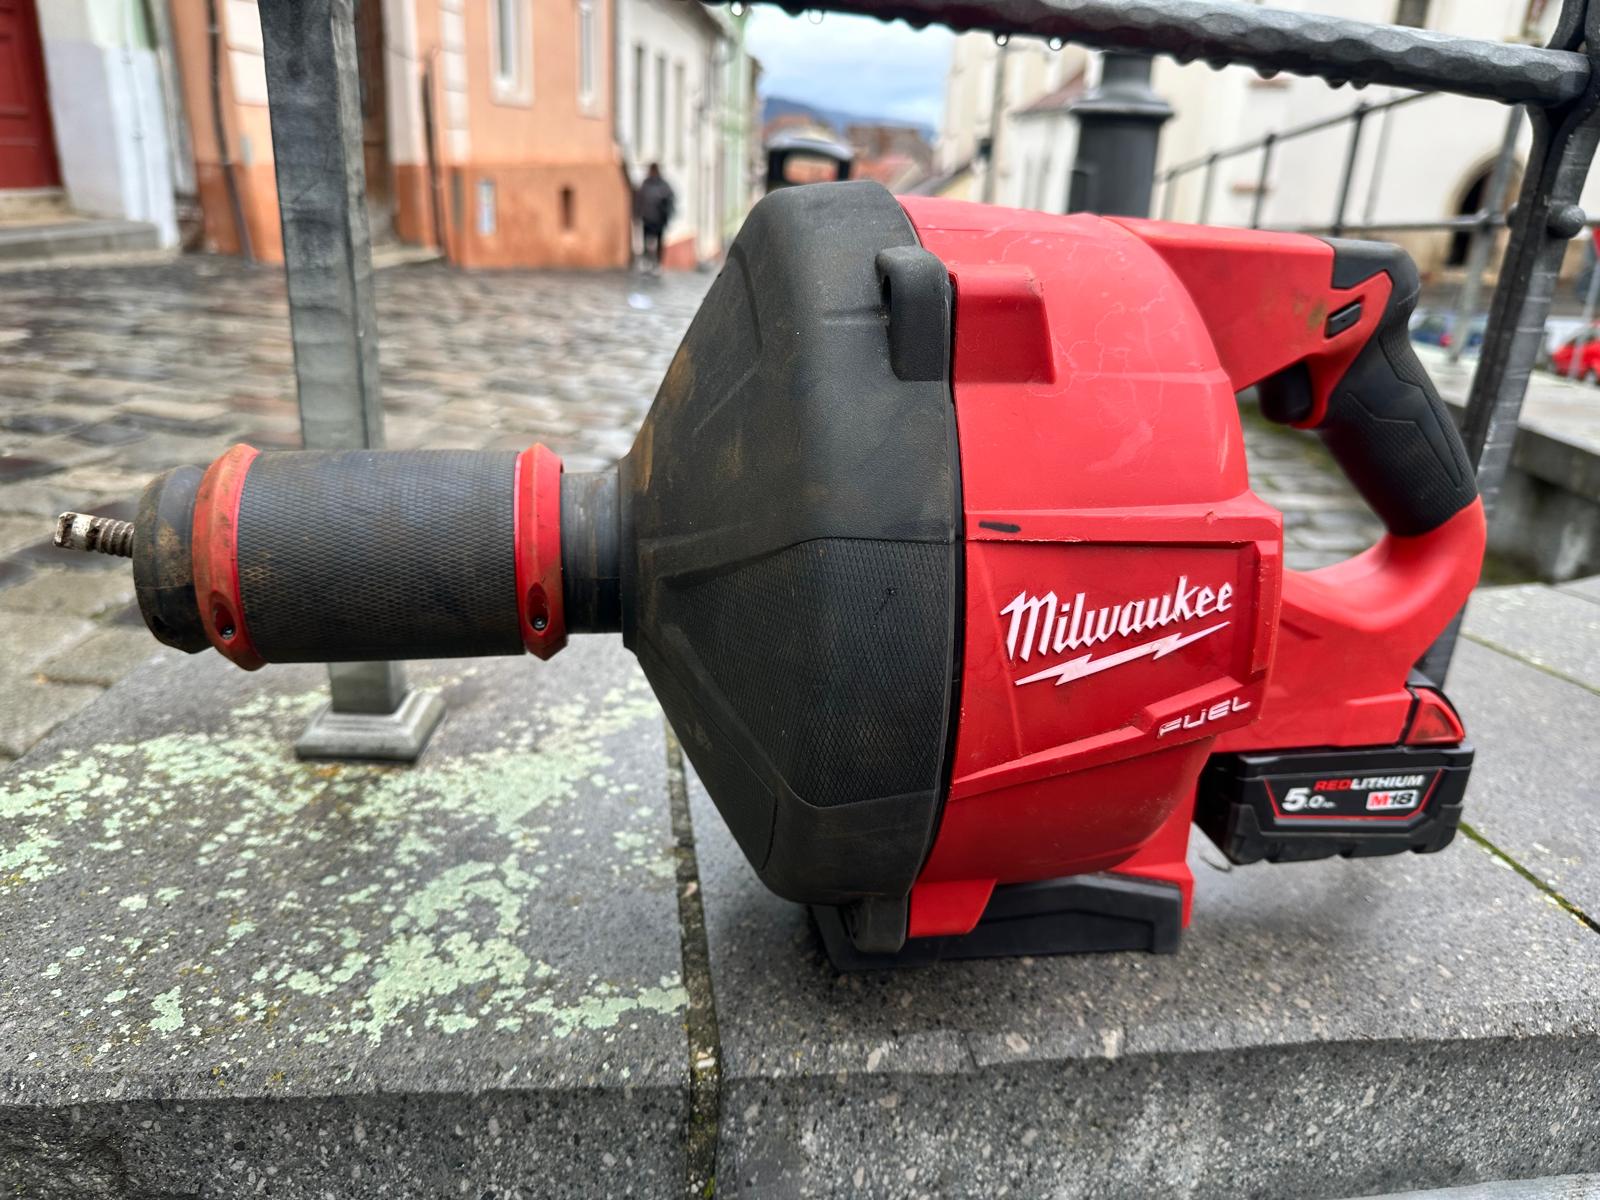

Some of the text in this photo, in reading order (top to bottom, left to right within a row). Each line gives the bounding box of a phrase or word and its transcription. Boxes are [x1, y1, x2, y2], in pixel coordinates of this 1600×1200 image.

[1000, 576, 1233, 662] Milwaukee
[1157, 697, 1251, 738] FUEL
[1313, 775, 1425, 791] REDLITHIUM
[1369, 792, 1414, 807] M18
